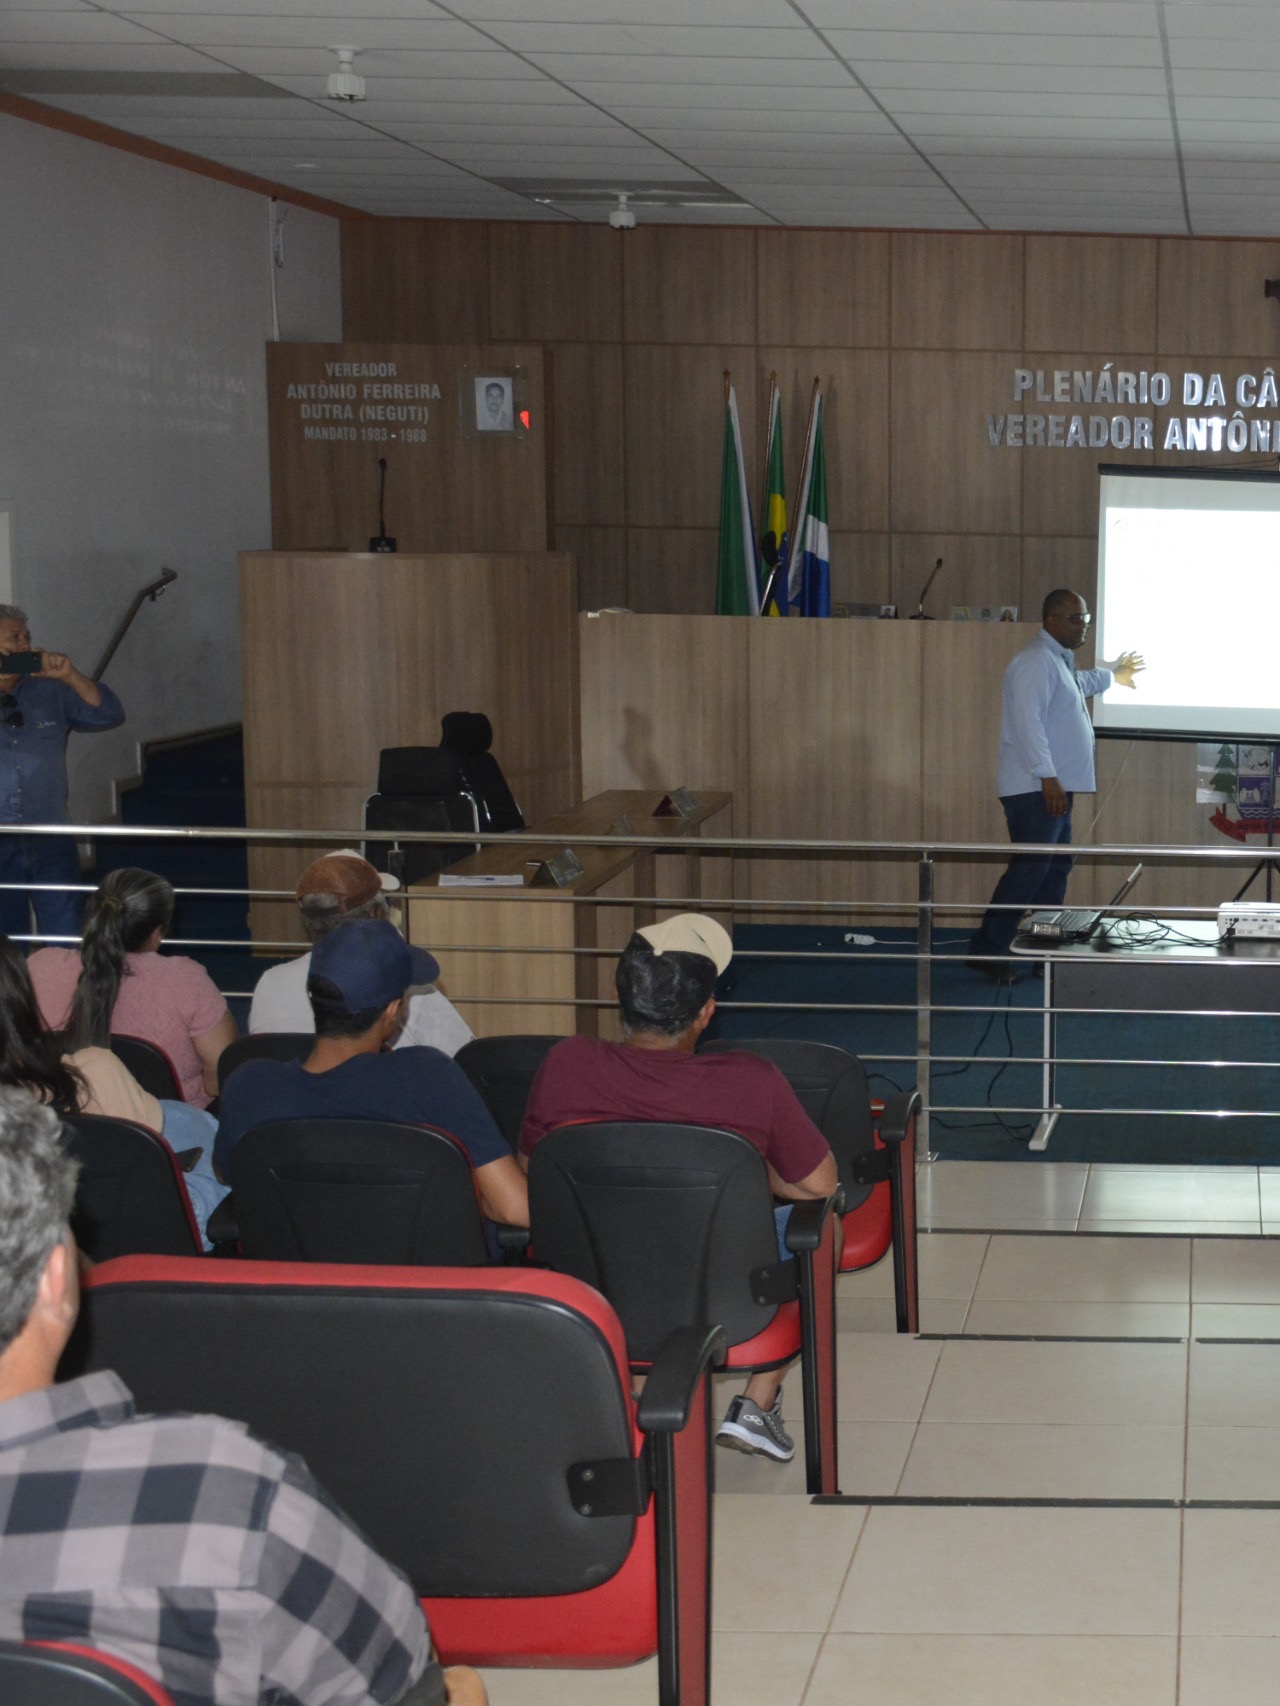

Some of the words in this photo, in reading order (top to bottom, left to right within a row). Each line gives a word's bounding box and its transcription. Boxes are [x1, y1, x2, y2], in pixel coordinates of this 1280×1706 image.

[325, 362, 397, 377] VEREADOR
[286, 380, 356, 399] ANTÔNIO
[363, 384, 441, 399] FERREIRA
[1014, 362, 1171, 406] PLENÁRIO
[1183, 373, 1226, 406] DA
[301, 404, 353, 419] DUTRA
[304, 426, 357, 441] MANDATO
[986, 414, 1154, 450] VEREADOR
